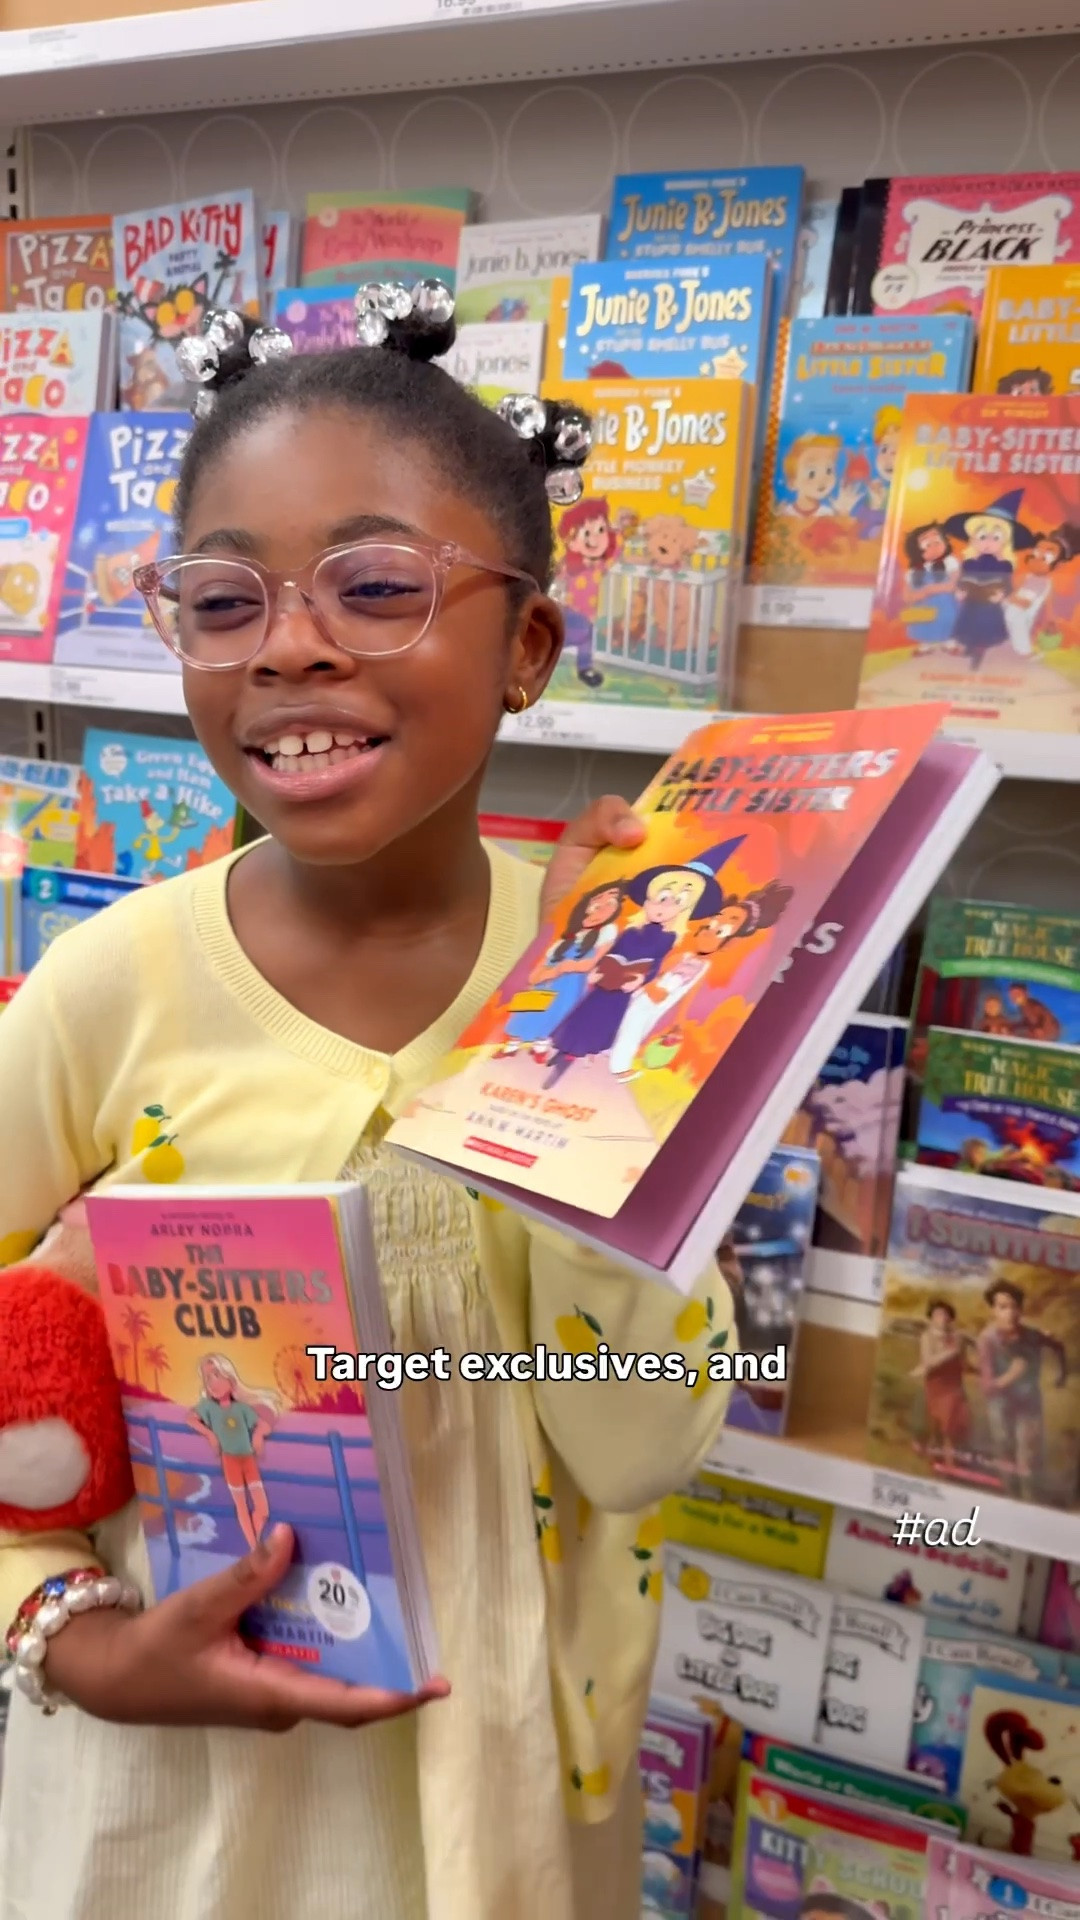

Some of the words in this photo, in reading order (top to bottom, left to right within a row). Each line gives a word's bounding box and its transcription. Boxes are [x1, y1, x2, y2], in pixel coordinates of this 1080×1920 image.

[617, 194, 689, 242] Junie
[713, 189, 787, 239] Jones
[124, 216, 175, 280] BAD
[922, 237, 1042, 263] BLACK
[576, 283, 650, 336] Junie
[675, 279, 752, 334] Jones
[646, 400, 726, 456] Jones
[135, 750, 182, 765] Green
[663, 748, 899, 785] BABY-SITTERS
[101, 784, 150, 804] Take
[178, 786, 223, 820] Hike
[655, 786, 743, 812] LITTLE
[745, 786, 854, 812] SISTER
[151, 1222, 194, 1237] ARLEY
[185, 1244, 224, 1265] THE
[108, 1262, 333, 1305] BABY-SITTERS
[175, 1303, 262, 1339] CLUB
